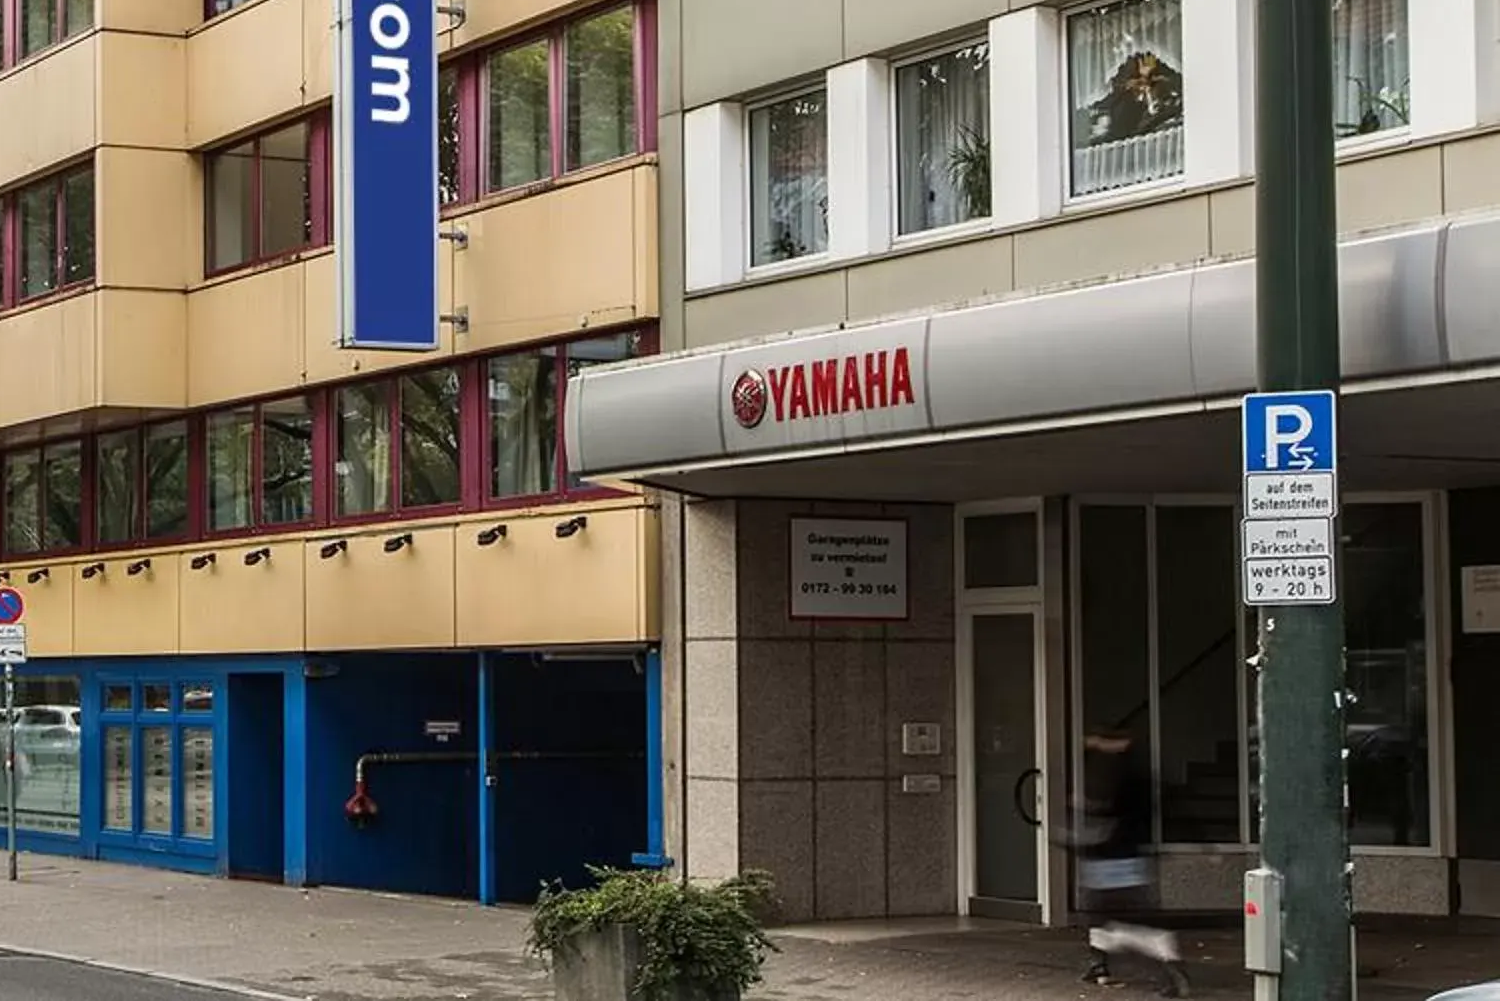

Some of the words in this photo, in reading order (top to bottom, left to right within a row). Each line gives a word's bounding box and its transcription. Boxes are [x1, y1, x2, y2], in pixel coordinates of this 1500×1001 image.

[767, 346, 915, 423] YAMAHA
[1266, 404, 1313, 469] P
[1267, 481, 1284, 494] auf
[1289, 481, 1314, 494] dem
[1251, 497, 1329, 511] Seitenstreifen
[1275, 528, 1297, 539] mit
[1251, 541, 1325, 554] Parkschein
[1251, 563, 1327, 580] werktags
[801, 582, 830, 594] 0172
[1255, 582, 1264, 596] 9
[1287, 582, 1306, 596] 20
[1313, 581, 1323, 596] h
